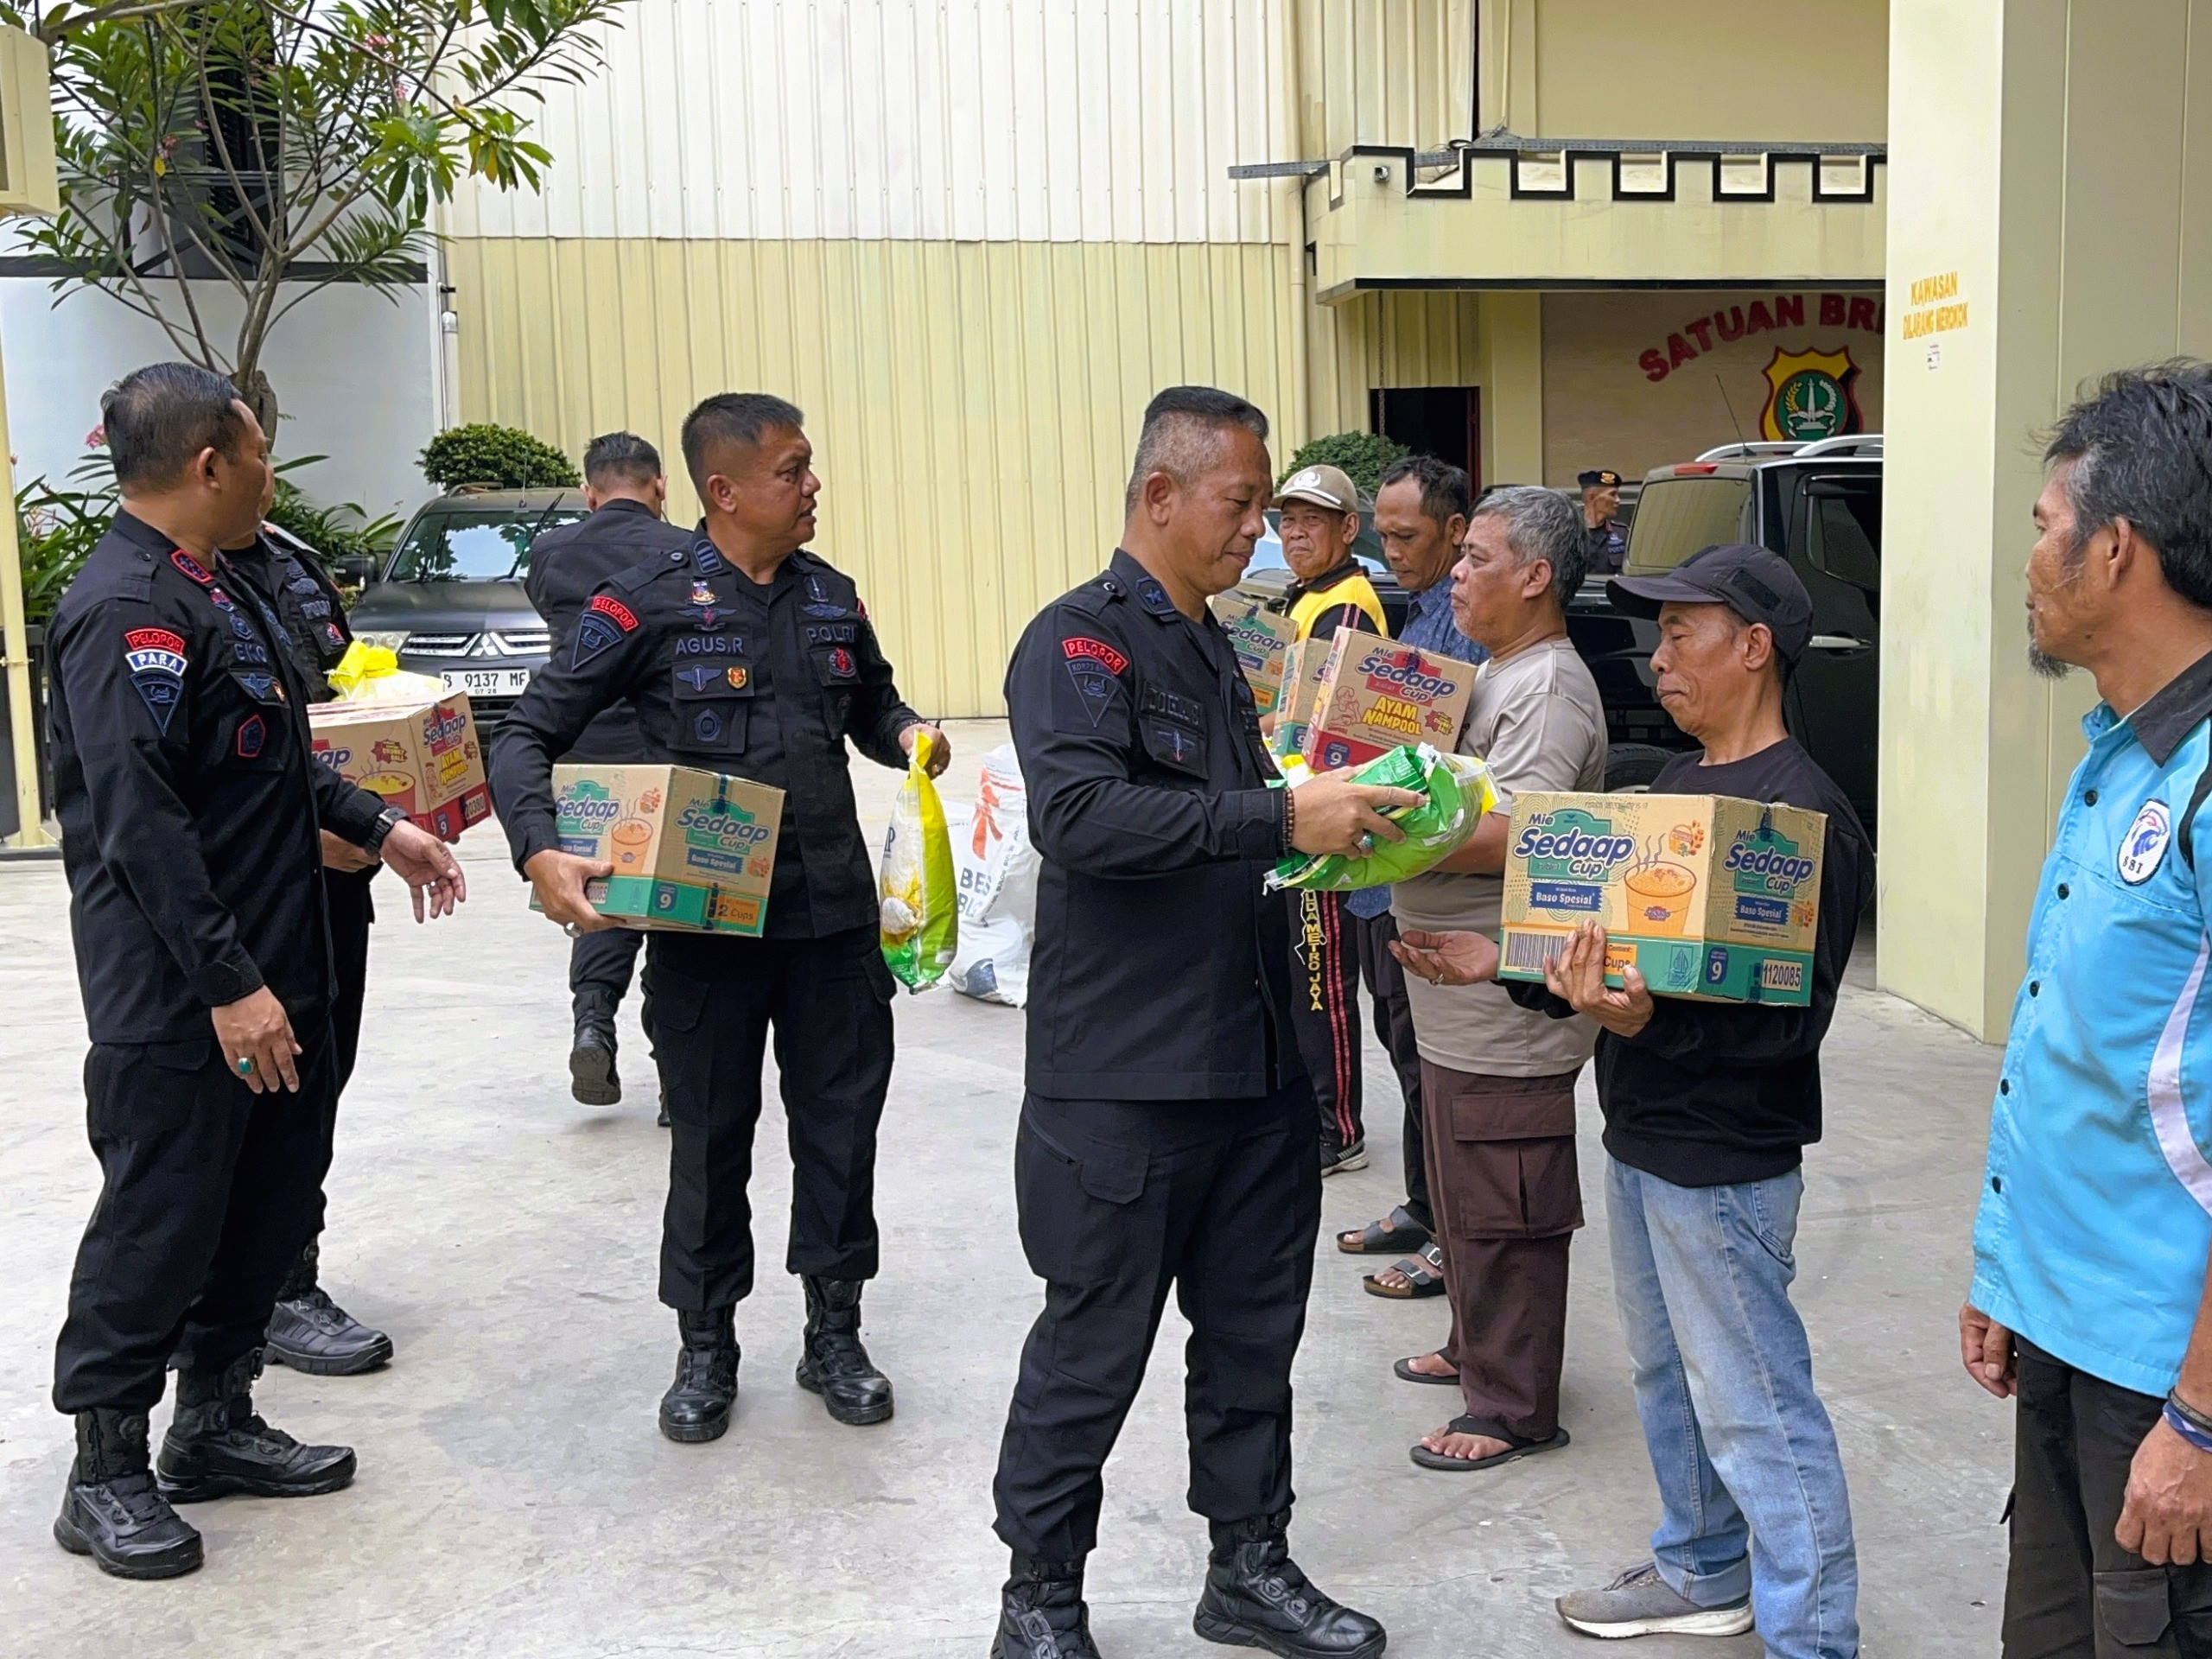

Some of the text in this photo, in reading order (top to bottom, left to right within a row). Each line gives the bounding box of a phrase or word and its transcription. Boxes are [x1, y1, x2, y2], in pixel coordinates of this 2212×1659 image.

[1638, 295, 1805, 382] SATUAN
[594, 599, 634, 628] PELOPOR
[130, 632, 181, 651] PELOPOR
[137, 652, 178, 671] PARA
[1067, 640, 1122, 671] PELOPOR
[1372, 647, 1395, 658] Mie
[465, 673, 499, 688] 9137
[1357, 656, 1457, 698] Sedaap
[1401, 687, 1428, 701] Cup
[1374, 696, 1419, 721] AYAM
[423, 715, 467, 747] Sedaap
[1362, 709, 1422, 735] NAMPOOL
[1330, 752, 1343, 766] 9
[582, 819, 600, 831] Cup
[677, 808, 770, 844] Sedaap
[1529, 813, 1554, 826] Mie
[440, 823, 448, 836] 9
[1736, 830, 1756, 842] Mie
[719, 836, 745, 850] Cup
[1514, 826, 1634, 867] Sedaap
[1568, 860, 1604, 879] Cup
[1724, 842, 1815, 885] Sedaap
[1765, 877, 1790, 894] Cup
[659, 893, 672, 909] 9
[1535, 892, 1592, 906] Baso Spesial
[730, 908, 753, 920] Cups
[1757, 906, 1782, 918] Spesial
[1306, 924, 1320, 971] METRO
[1711, 961, 1723, 981] 9
[1763, 963, 1801, 987] 1120085
[1309, 972, 1323, 1011] JAYA
